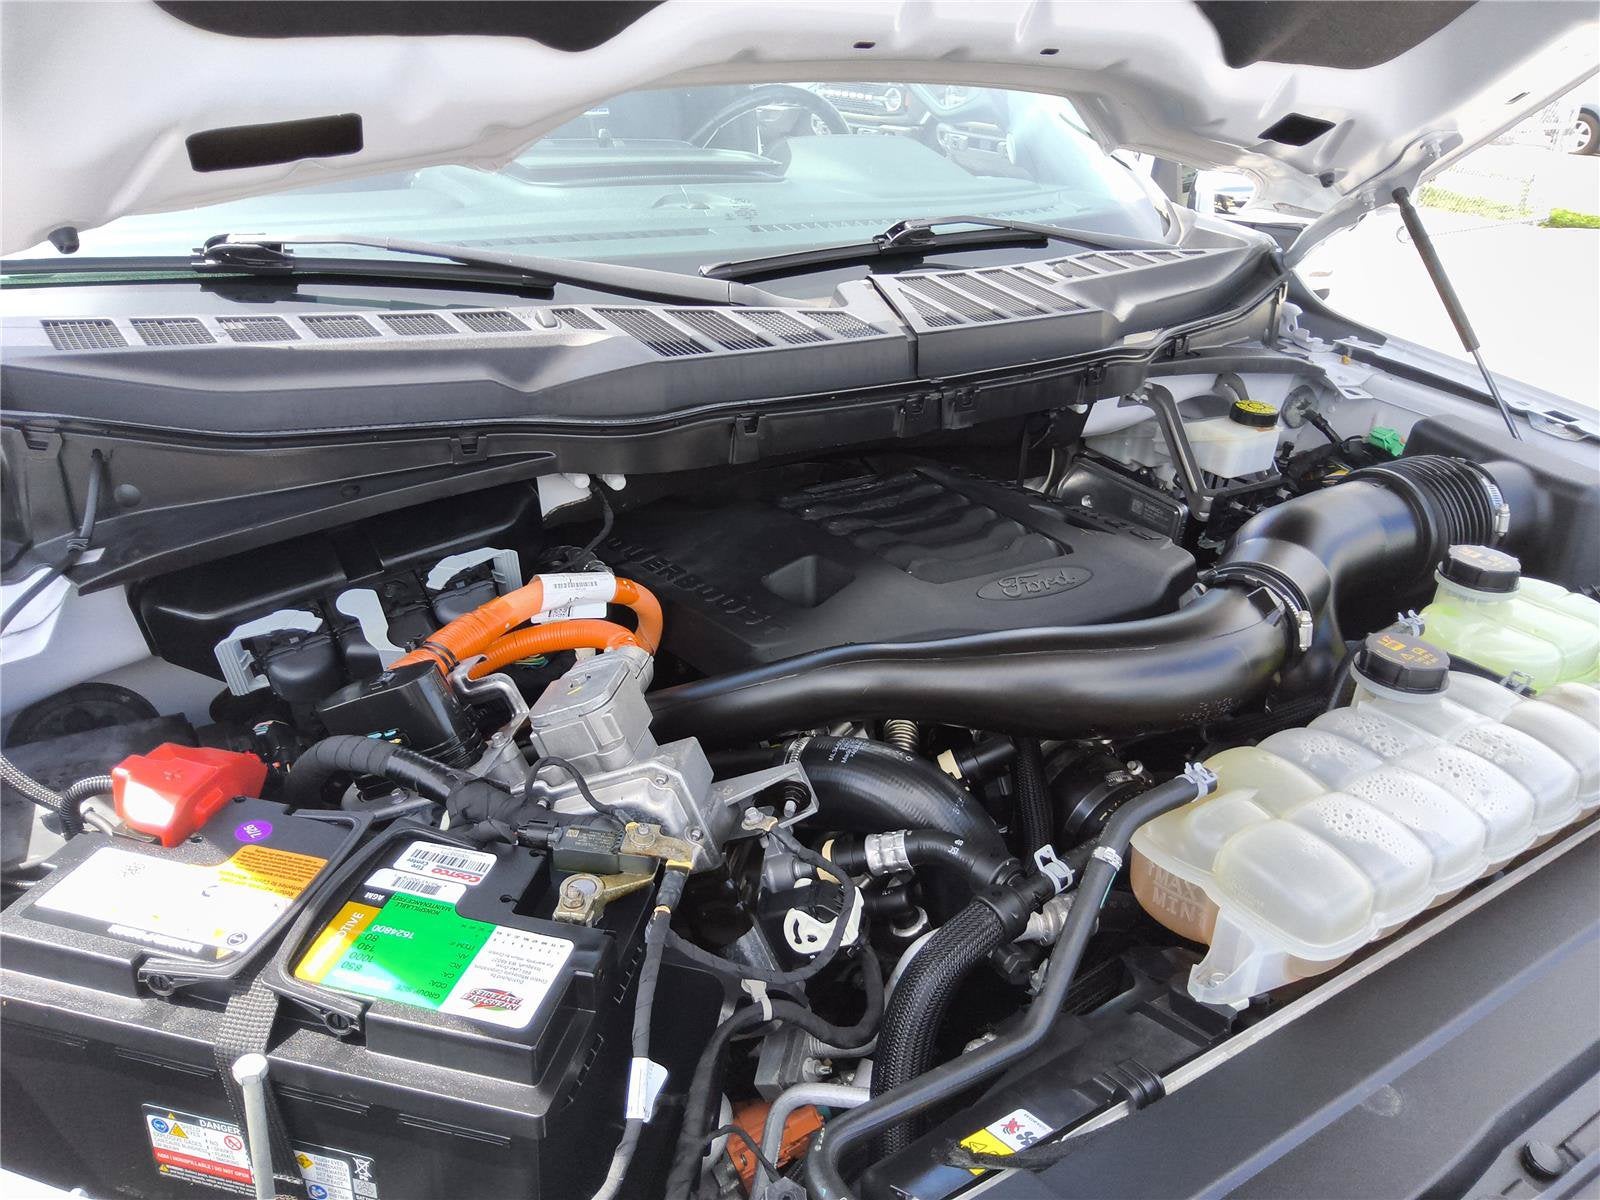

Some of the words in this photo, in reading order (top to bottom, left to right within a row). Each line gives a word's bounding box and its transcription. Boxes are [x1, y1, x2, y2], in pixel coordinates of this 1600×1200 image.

[998, 567, 1069, 598] Ford
[411, 863, 425, 871] Tire
[431, 868, 480, 883] COSTCO
[1155, 871, 1196, 901] MAX
[364, 891, 385, 901] AGM
[1152, 887, 1197, 922] MIN
[364, 933, 379, 943] 80
[371, 924, 415, 940] 1624800
[356, 942, 376, 952] 140
[348, 952, 374, 963] 1000
[341, 961, 362, 972] 850
[464, 993, 520, 1012] INTERSTATE
[472, 990, 522, 1006] BATTERIES
[199, 1119, 242, 1136] DANGER
